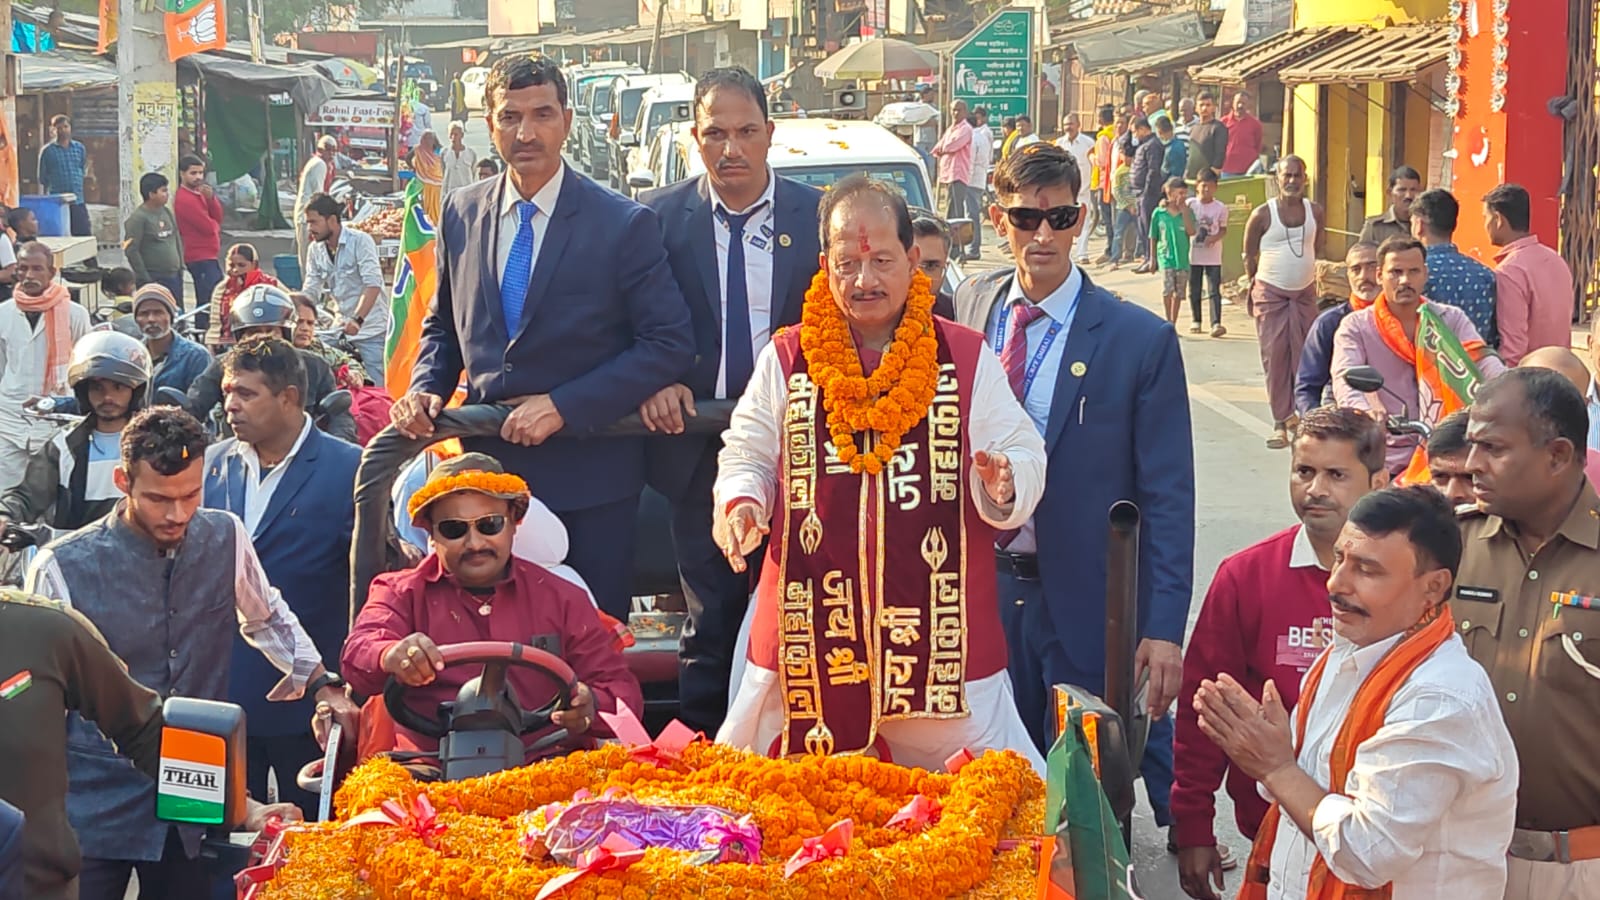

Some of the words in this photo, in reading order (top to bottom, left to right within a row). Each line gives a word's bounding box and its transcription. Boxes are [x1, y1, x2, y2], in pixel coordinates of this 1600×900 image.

[322, 105, 350, 114] Rahul
[353, 106, 396, 116] Fast-Foo
[787, 373, 817, 509] महाकाल
[822, 570, 857, 642] जय
[879, 605, 922, 647] श्री
[784, 578, 823, 720] महाकाल
[825, 646, 870, 687] श्री
[925, 572, 962, 713] महाकाल
[883, 648, 919, 714] जय
[163, 769, 219, 789] THAR
